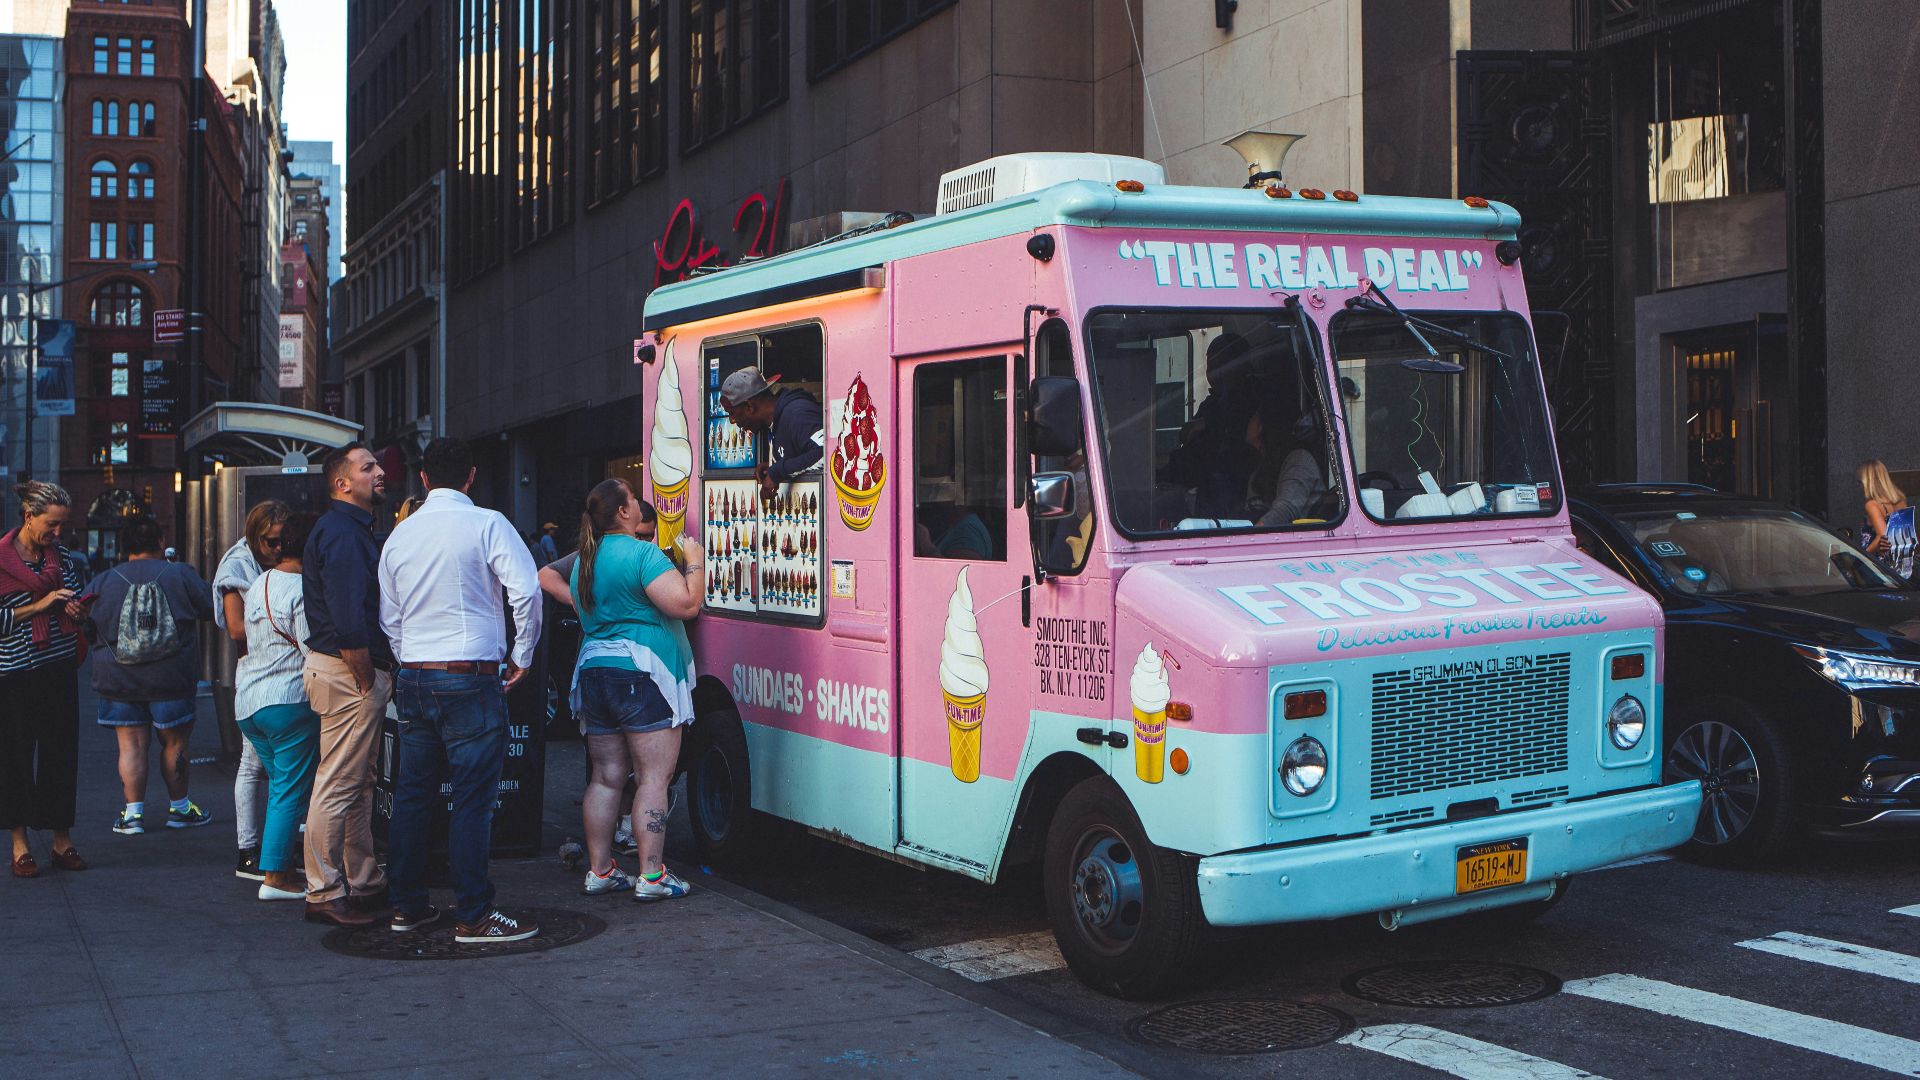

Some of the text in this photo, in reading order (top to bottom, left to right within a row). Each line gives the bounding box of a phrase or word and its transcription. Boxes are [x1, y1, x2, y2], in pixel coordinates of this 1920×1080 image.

[1244, 242, 1359, 290] REAL
[156, 313, 165, 321] NO
[656, 490, 686, 515] FUN-TIME
[841, 499, 873, 519] FUN-TIME
[1216, 562, 1629, 626] FROSTEE
[1036, 617, 1109, 647] SMOOTHIE INC.
[1316, 606, 1608, 652] Delicious Frostee Treats
[1034, 643, 1051, 668] 328
[1098, 648, 1114, 675] ST.
[1413, 654, 1533, 681] GRUMMAN OLSON
[732, 663, 889, 734] SUNDAES SHAKES
[1040, 669, 1105, 701] BK. N.Y. 11206
[947, 700, 982, 723] FUN-TIME
[1134, 718, 1165, 734] FUN-TIME
[508, 743, 524, 757] 30
[1475, 843, 1511, 855] NEW YORK
